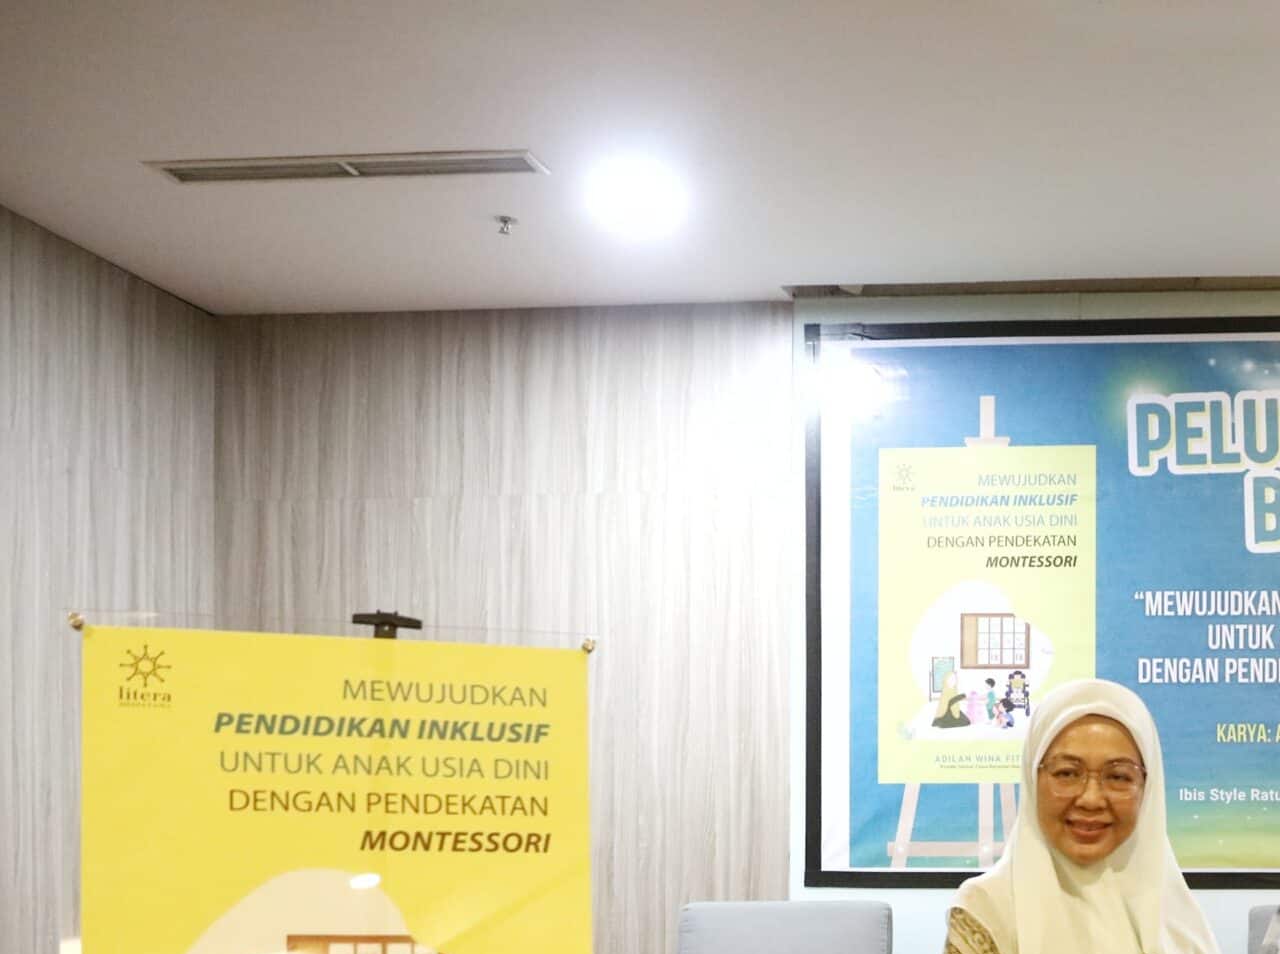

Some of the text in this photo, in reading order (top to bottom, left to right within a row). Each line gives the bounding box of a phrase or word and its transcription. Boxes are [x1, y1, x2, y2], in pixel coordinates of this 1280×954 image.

[977, 473, 1078, 487] MEWUJUDKAN
[920, 493, 1078, 508] PENDIDIKAN INKLUSIF
[923, 514, 1078, 528] UNTUK ANAK USIA DINI
[926, 535, 1077, 549] DENGAN PENDEKATAN
[985, 555, 1078, 568] MONTESSORI
[1207, 624, 1275, 650] UNTUK
[1138, 659, 1217, 684] DENGAN
[119, 685, 172, 702] litera
[341, 679, 548, 708] MEWUJUDKAN
[213, 711, 550, 744] PENDIDIKAN INKLUSIF
[1216, 723, 1271, 744] KARYA:
[219, 750, 550, 781] UNTUK ANAK USIA DINI
[228, 788, 549, 817] DENGAN PENDEKATAN
[1178, 788, 1206, 802] Ibis
[1209, 788, 1247, 805] Style
[360, 830, 552, 855] MONTESSORI
